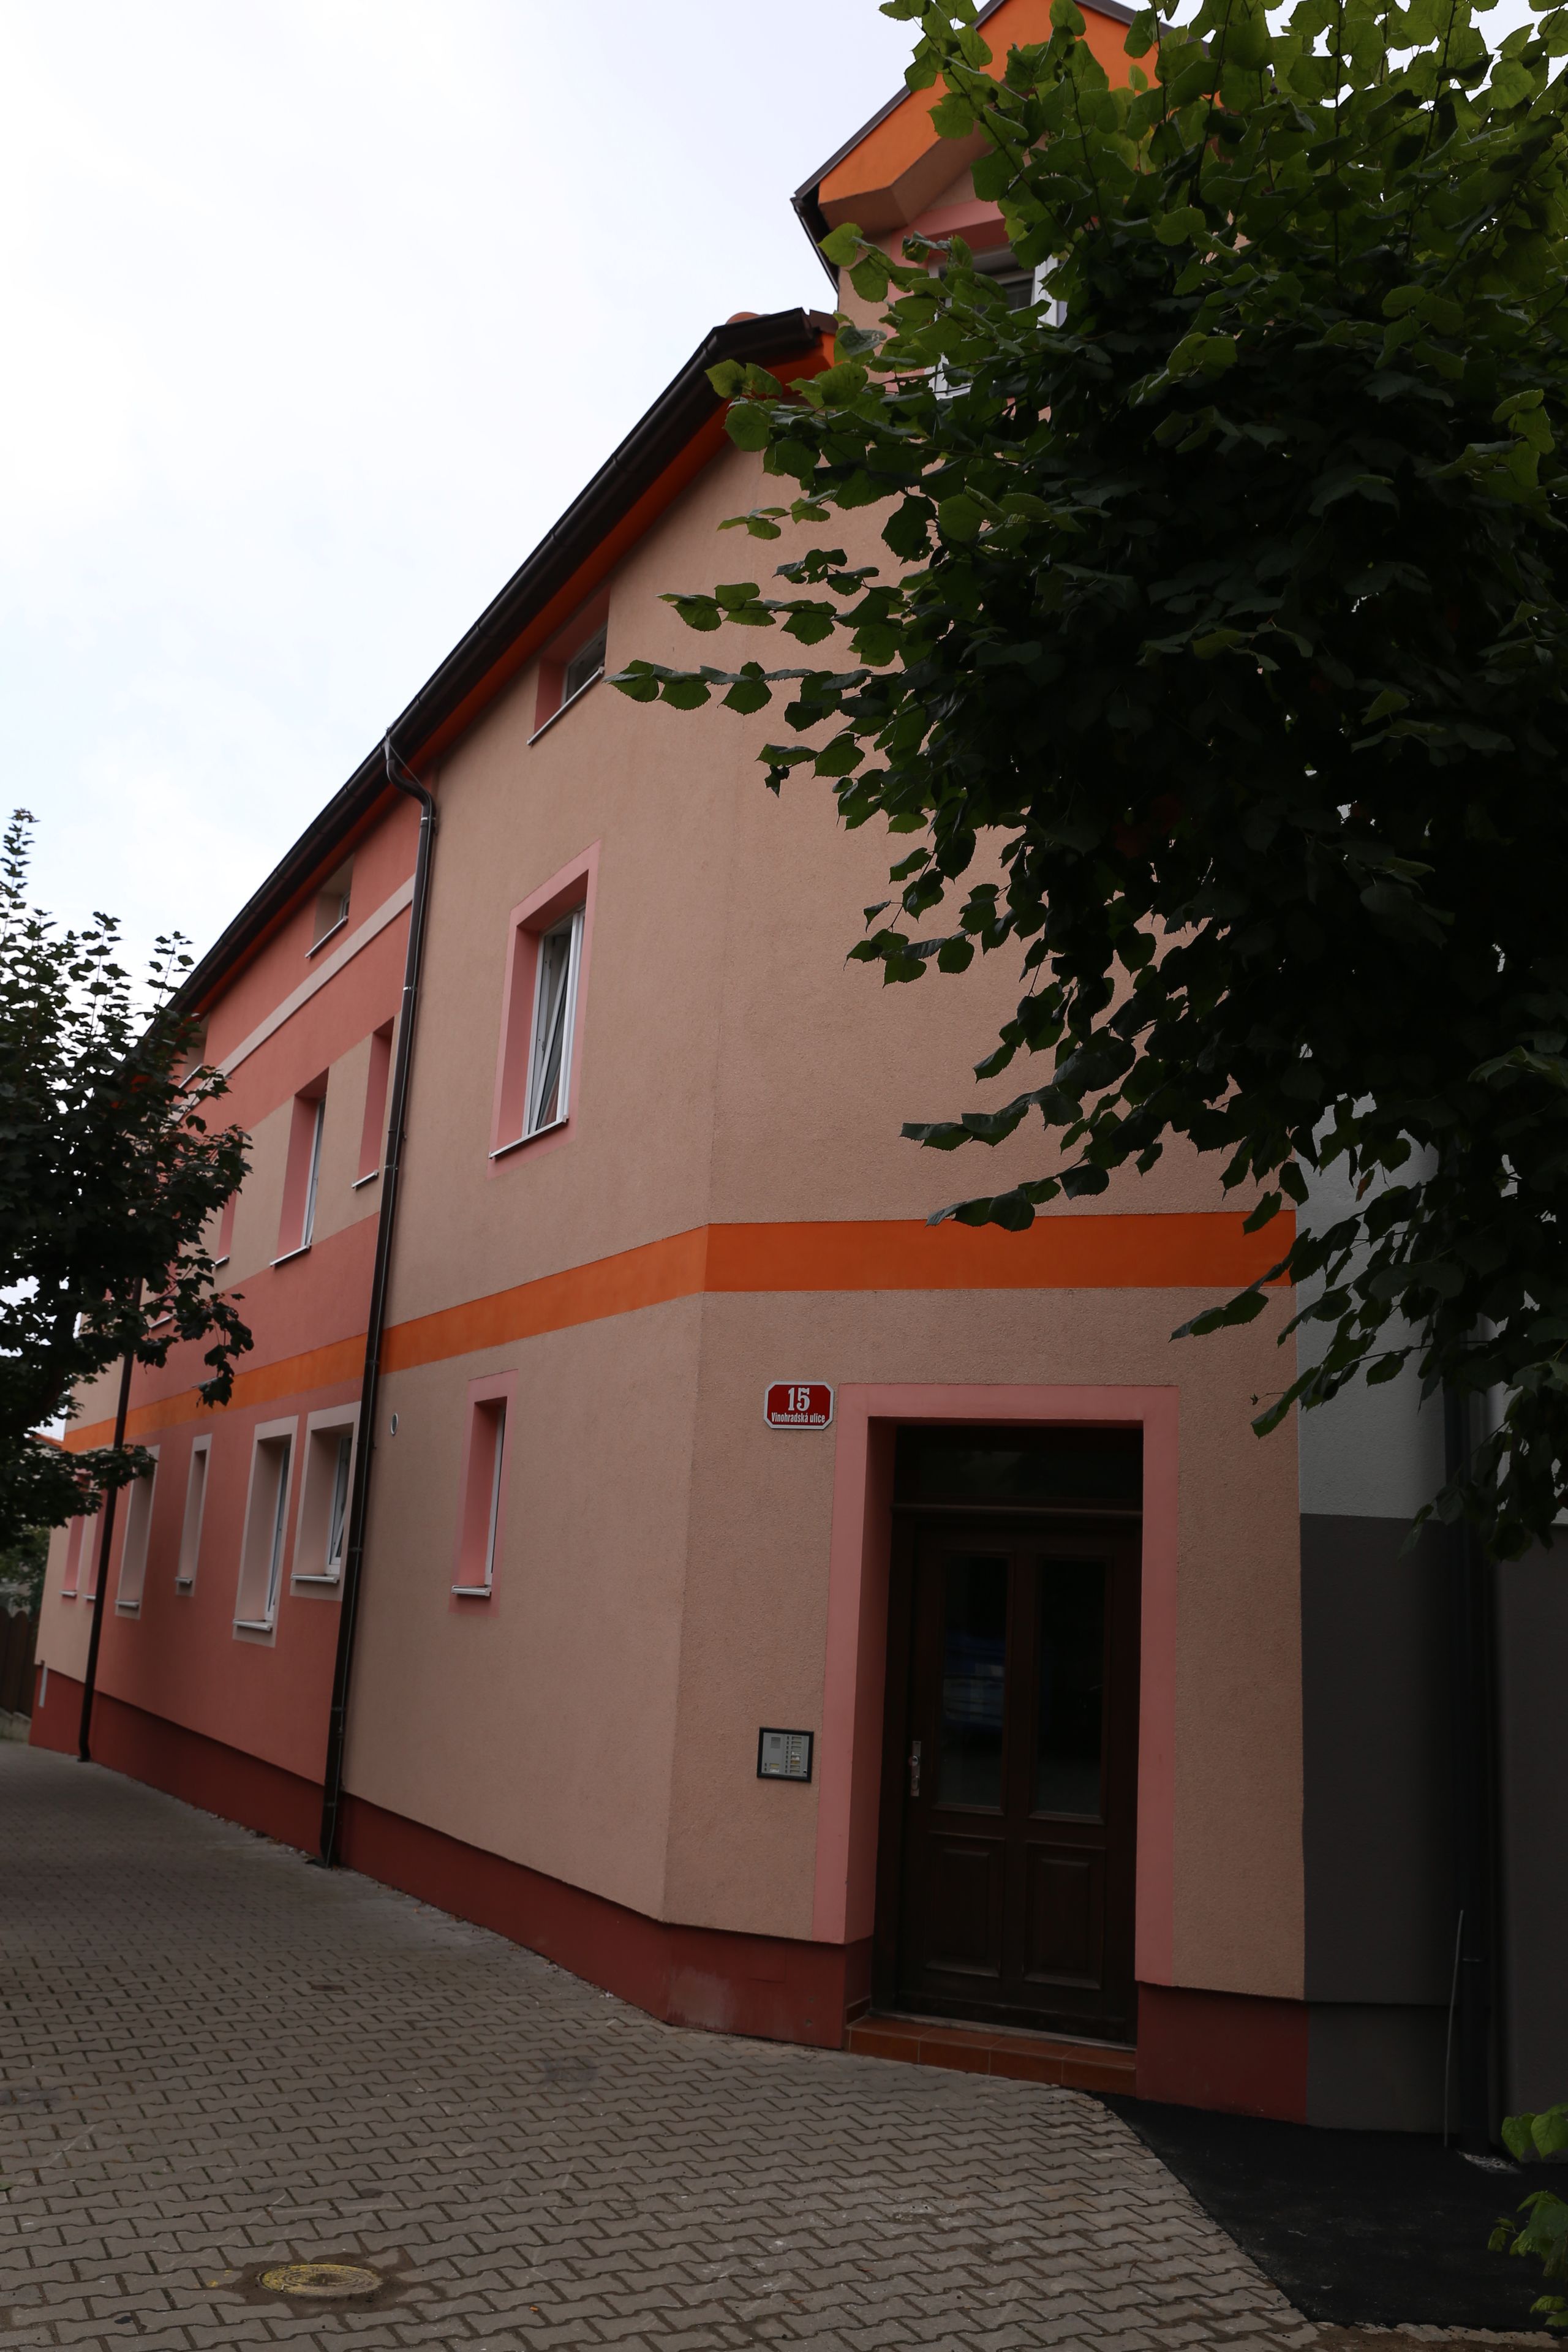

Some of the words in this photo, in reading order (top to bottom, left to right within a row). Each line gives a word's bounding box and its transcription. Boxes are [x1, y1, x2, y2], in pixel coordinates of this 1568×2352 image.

[788, 1387, 810, 1411] 15
[771, 1412, 809, 1422] Vinohradská
[810, 1413, 826, 1423] ulice
